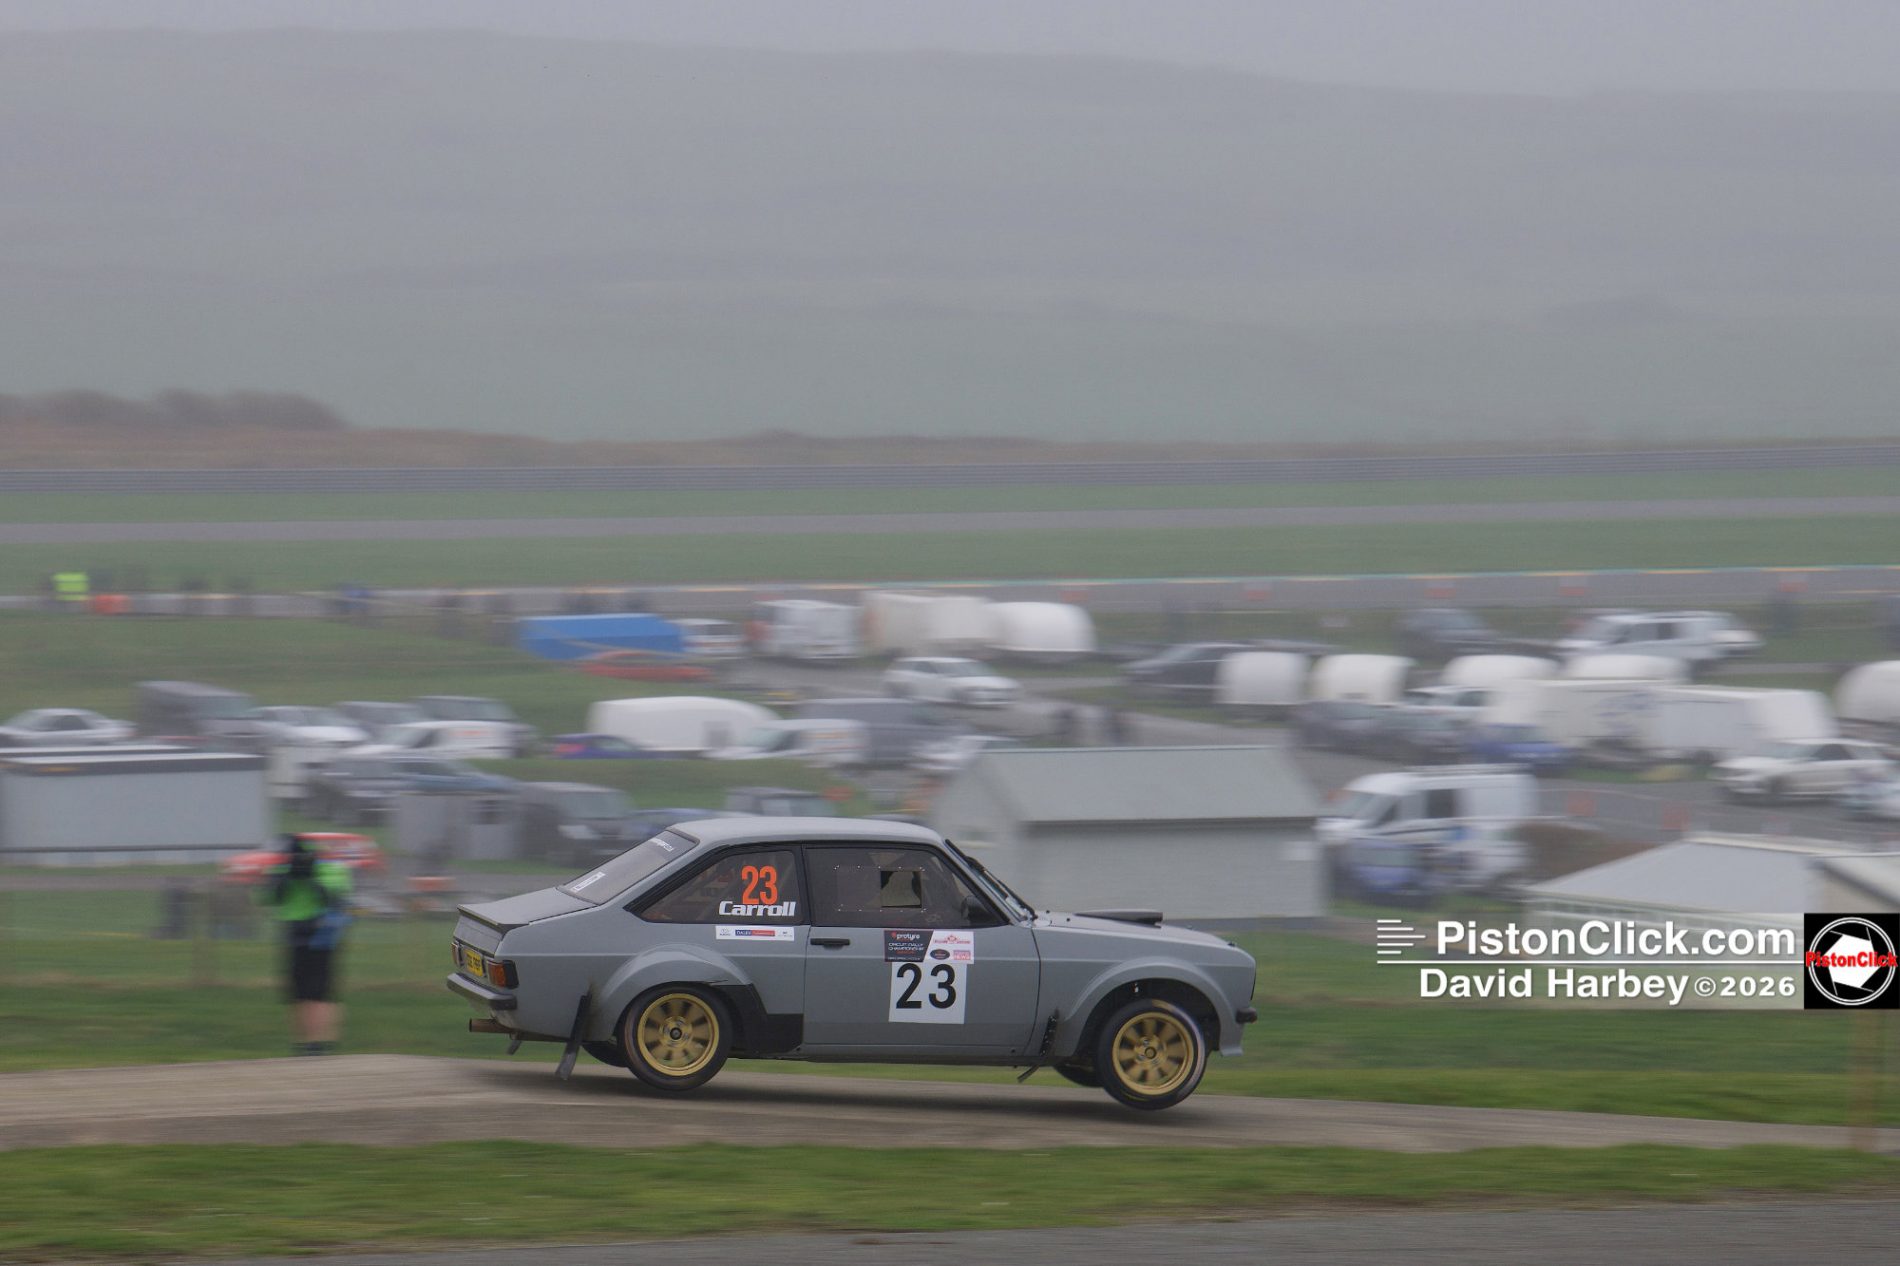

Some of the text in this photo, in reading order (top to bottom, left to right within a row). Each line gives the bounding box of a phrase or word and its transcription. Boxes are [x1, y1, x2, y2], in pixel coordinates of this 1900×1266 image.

[741, 865, 778, 905] 23
[719, 900, 796, 916] Carroll
[896, 933, 920, 941] protyre
[896, 963, 957, 1009] 23
